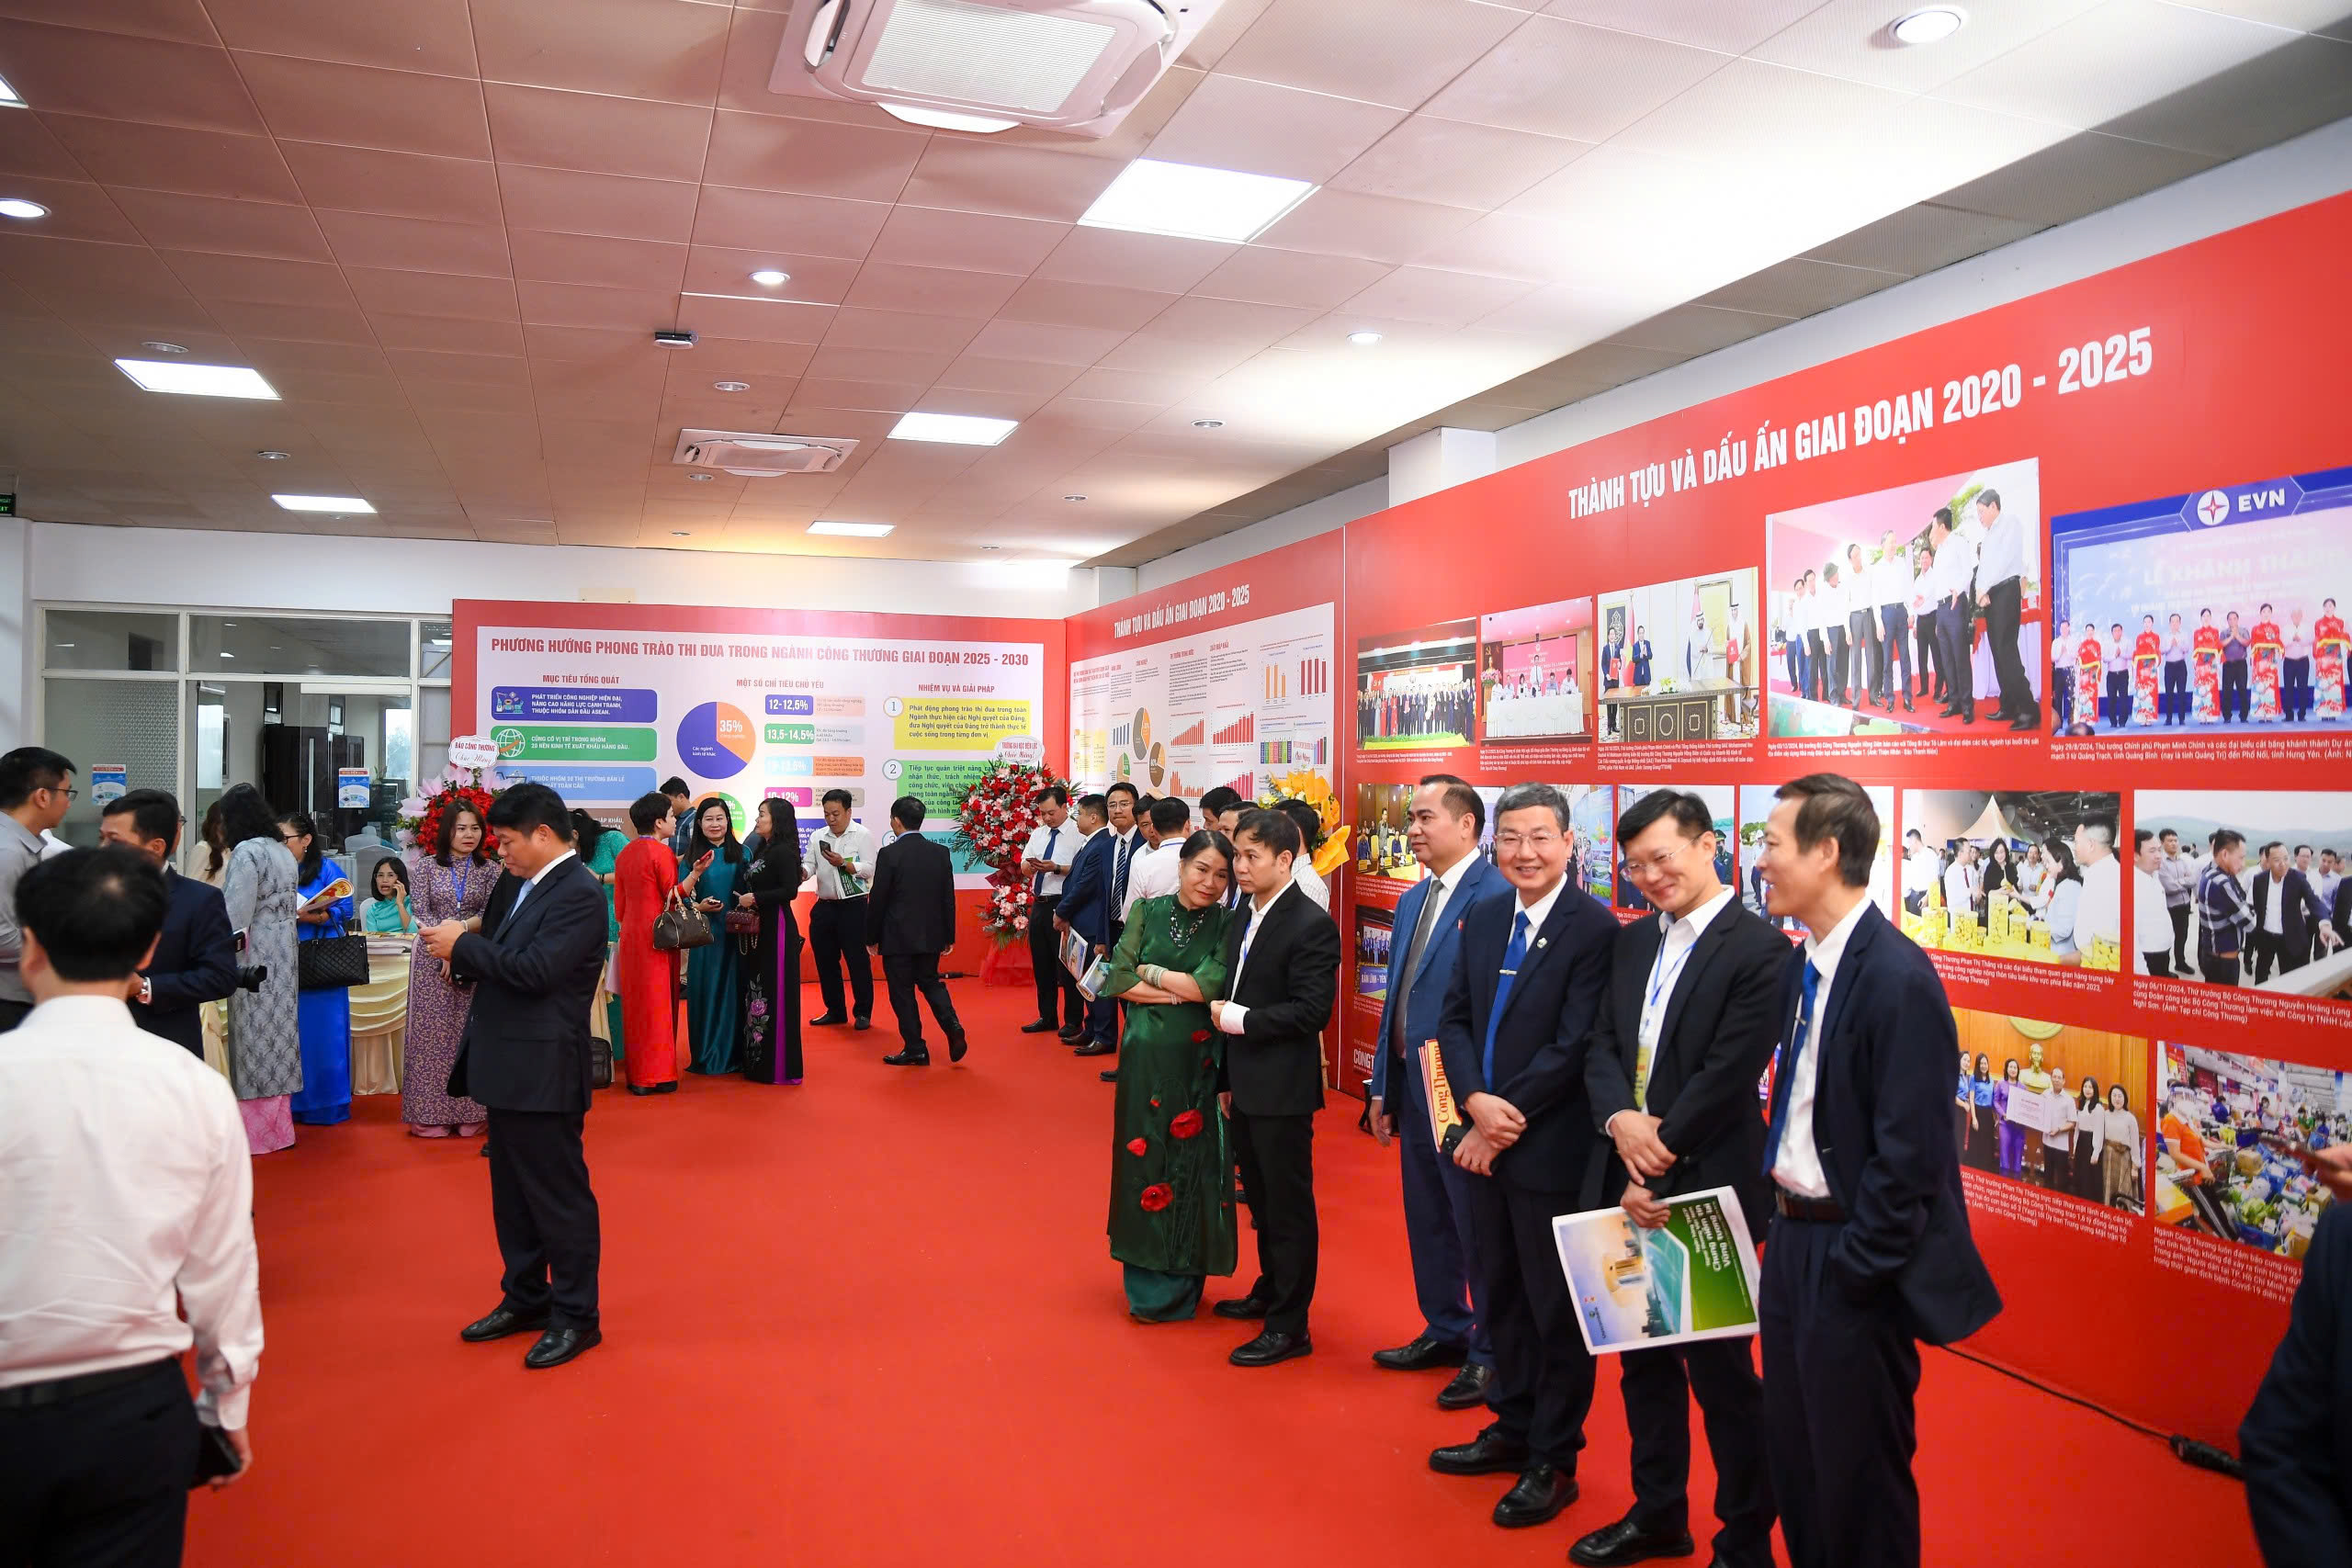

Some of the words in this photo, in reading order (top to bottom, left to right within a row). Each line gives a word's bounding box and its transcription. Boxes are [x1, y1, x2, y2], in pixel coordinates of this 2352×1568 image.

[1568, 474, 1625, 519] THÀNH
[1630, 463, 1665, 507] TỰU
[1671, 447, 1697, 492] VÀ
[1703, 436, 1747, 480] DẤU
[1754, 421, 1788, 473] ẤN
[1795, 410, 1846, 462] GIAI
[1854, 387, 1932, 446] ĐOẠN
[1943, 363, 2021, 424] 2020
[2032, 376, 2046, 388] -
[2058, 327, 2153, 394] 2025
[2238, 488, 2285, 512] EVN
[1114, 617, 1131, 638] THÀNH
[1132, 614, 1143, 637] TỰU
[1144, 610, 1150, 631] VÀ
[1152, 603, 1164, 628] DẤU
[1165, 601, 1173, 625] ẤN
[1175, 602, 1187, 623] GIAI
[1189, 596, 1207, 621] ĐOẠN
[1208, 591, 1225, 614] 2020
[1232, 584, 1249, 607] 2025
[492, 638, 544, 652] PHƯƠNG
[548, 638, 591, 653] HƯỚNG
[596, 641, 638, 655] PHONG
[643, 641, 674, 655] TRÀO
[678, 644, 696, 656] THI
[700, 645, 724, 657] ĐUA
[728, 645, 768, 658] TRONG
[771, 644, 813, 659] NGÀNH
[818, 646, 849, 661] CÔNG
[853, 648, 899, 662] THƯƠNG
[902, 651, 925, 663] GIAI
[929, 651, 960, 666] ĐOẠN
[963, 653, 990, 665] 2025
[1002, 653, 1028, 666] 2030
[543, 675, 559, 684] MỤC
[562, 674, 577, 683] TIÊU
[580, 673, 599, 684] TỔNG
[601, 675, 619, 684] QUÁT
[736, 678, 751, 688] MỘT
[753, 678, 763, 687] SỐ
[765, 678, 777, 687] CHỈ
[795, 679, 809, 688] CHỦ
[811, 679, 824, 689] YẾU
[918, 684, 940, 693] NHIỆM
[942, 685, 951, 694] VỤ
[952, 684, 961, 692] VÀ
[962, 684, 976, 693] GIẢI
[977, 685, 995, 693] PHÁP
[769, 699, 808, 711] 12-12,5%
[891, 701, 896, 712] 1
[720, 720, 742, 732] 35%
[767, 729, 814, 740] 13,5-14,5%
[2051, 743, 2064, 751] Ngày
[2107, 742, 2123, 751] tướng
[2141, 741, 2152, 750] phủ
[2154, 742, 2170, 750] Phạm
[2229, 740, 2239, 748] đại
[2268, 740, 2284, 749] băng
[890, 764, 897, 774] 2
[1957, 974, 1969, 983] Công
[1971, 976, 1989, 985] Thương)
[2133, 980, 2148, 989] Ngày
[2188, 987, 2198, 995] Thứ
[2200, 989, 2221, 999] trưởng
[2223, 991, 2231, 1000] Bộ
[2233, 993, 2250, 1004] Công
[2252, 995, 2277, 1007] Thương
[2279, 999, 2305, 1010] Nguyễn
[2307, 1003, 2330, 1014] Hoàng
[2332, 1006, 2350, 1018] Long
[1354, 1048, 1370, 1068] CÔNG
[2154, 1226, 2173, 1238] Ngành
[2175, 1233, 2191, 1244] Công
[2193, 1236, 2216, 1252] Thương
[2218, 1244, 2232, 1255] luôn
[2234, 1248, 2249, 1261] đảm
[2250, 1254, 2263, 1264] bảo
[2264, 1259, 2281, 1272] cung
